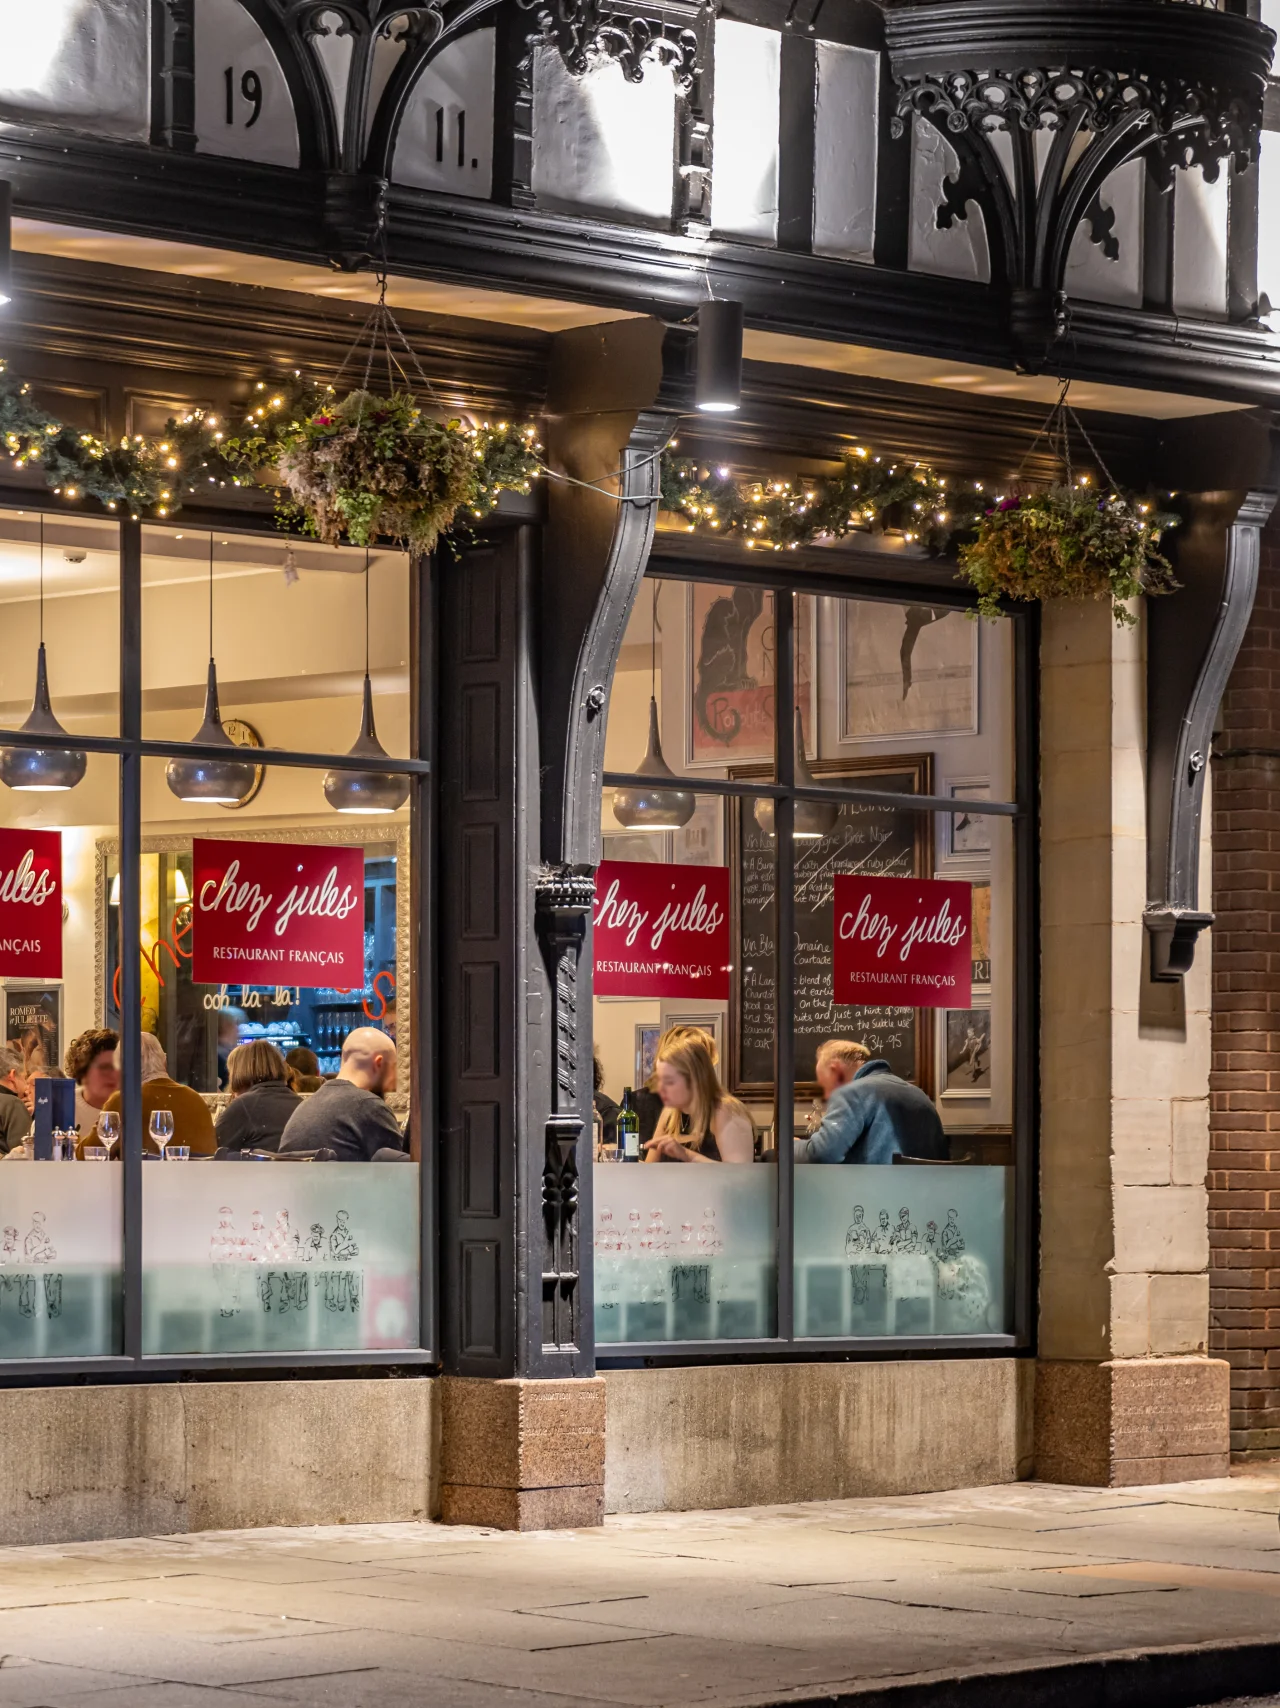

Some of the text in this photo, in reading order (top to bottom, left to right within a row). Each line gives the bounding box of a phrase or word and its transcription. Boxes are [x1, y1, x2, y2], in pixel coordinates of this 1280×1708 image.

[224, 66, 262, 128] 19
[760, 830, 775, 848] Rou
[870, 826, 891, 843] Noir
[199, 859, 358, 936] chez jules
[651, 884, 723, 950] jules
[839, 893, 967, 961] chez jules
[759, 934, 775, 953] Bla
[213, 946, 344, 966] RESTAURANT FRANÇAIS
[596, 960, 659, 974] RESTAURANT
[800, 974, 821, 985] blend
[823, 974, 831, 986] of
[850, 971, 956, 988] RESTAURANT FRANÇAIS
[204, 984, 230, 1010] ooh
[241, 986, 262, 1008] la
[746, 988, 775, 999] Chardon
[810, 988, 834, 997] earlie
[744, 1001, 761, 1012] good
[800, 1000, 811, 1008] On
[813, 998, 827, 1007] the
[14, 1014, 48, 1026] JULIETTE
[814, 1011, 831, 1020] and
[831, 1010, 852, 1024] just
[864, 1006, 882, 1015] hint
[833, 1022, 854, 1033] from
[857, 1020, 870, 1030] the
[897, 1019, 910, 1028] use
